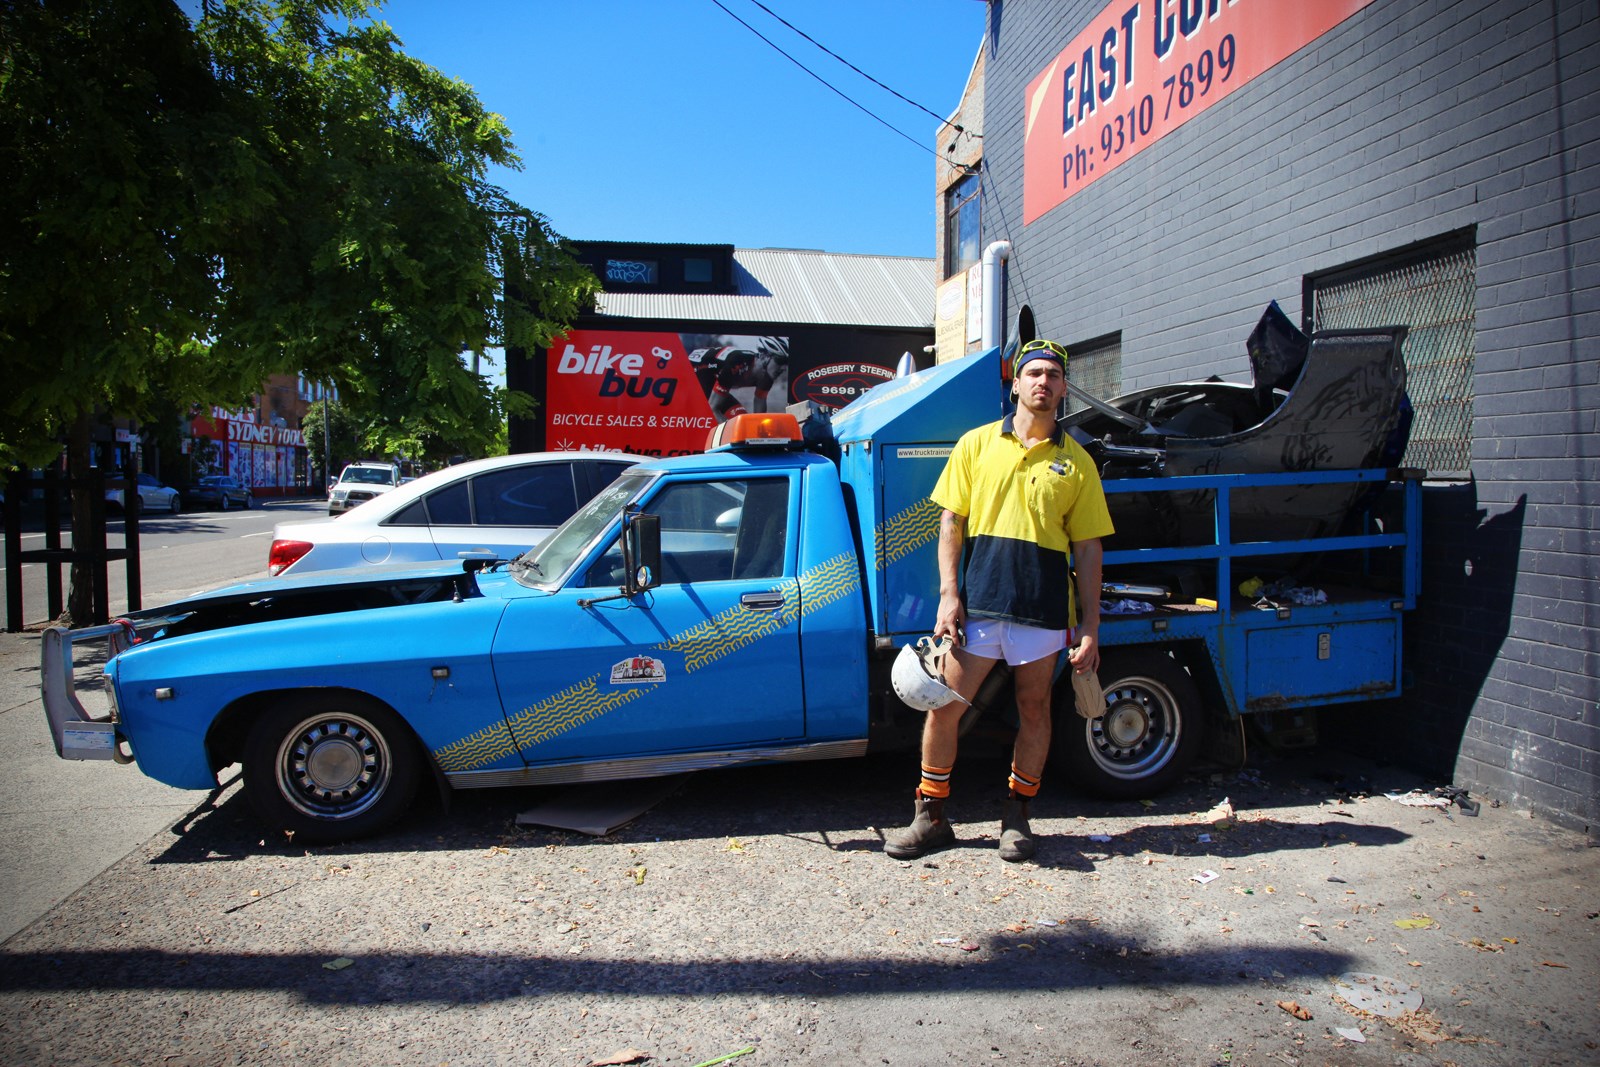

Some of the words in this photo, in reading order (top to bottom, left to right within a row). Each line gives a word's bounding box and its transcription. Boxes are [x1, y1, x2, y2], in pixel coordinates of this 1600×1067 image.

[1062, 2, 1141, 138] EAST
[1062, 144, 1094, 189] Ph:
[1100, 94, 1154, 162] 9310
[1162, 33, 1236, 121] 7899
[557, 344, 644, 376] bike
[807, 364, 856, 381] ROSEBERY
[859, 364, 898, 380] STEERIN
[598, 368, 678, 407] bug
[821, 386, 856, 395] 9698
[227, 421, 277, 444] SYDNEY
[552, 413, 604, 426] BICYCLE
[606, 415, 644, 427] SALES
[647, 415, 658, 428] &
[661, 416, 713, 429] SERVICE
[580, 443, 705, 457] bikebugco
